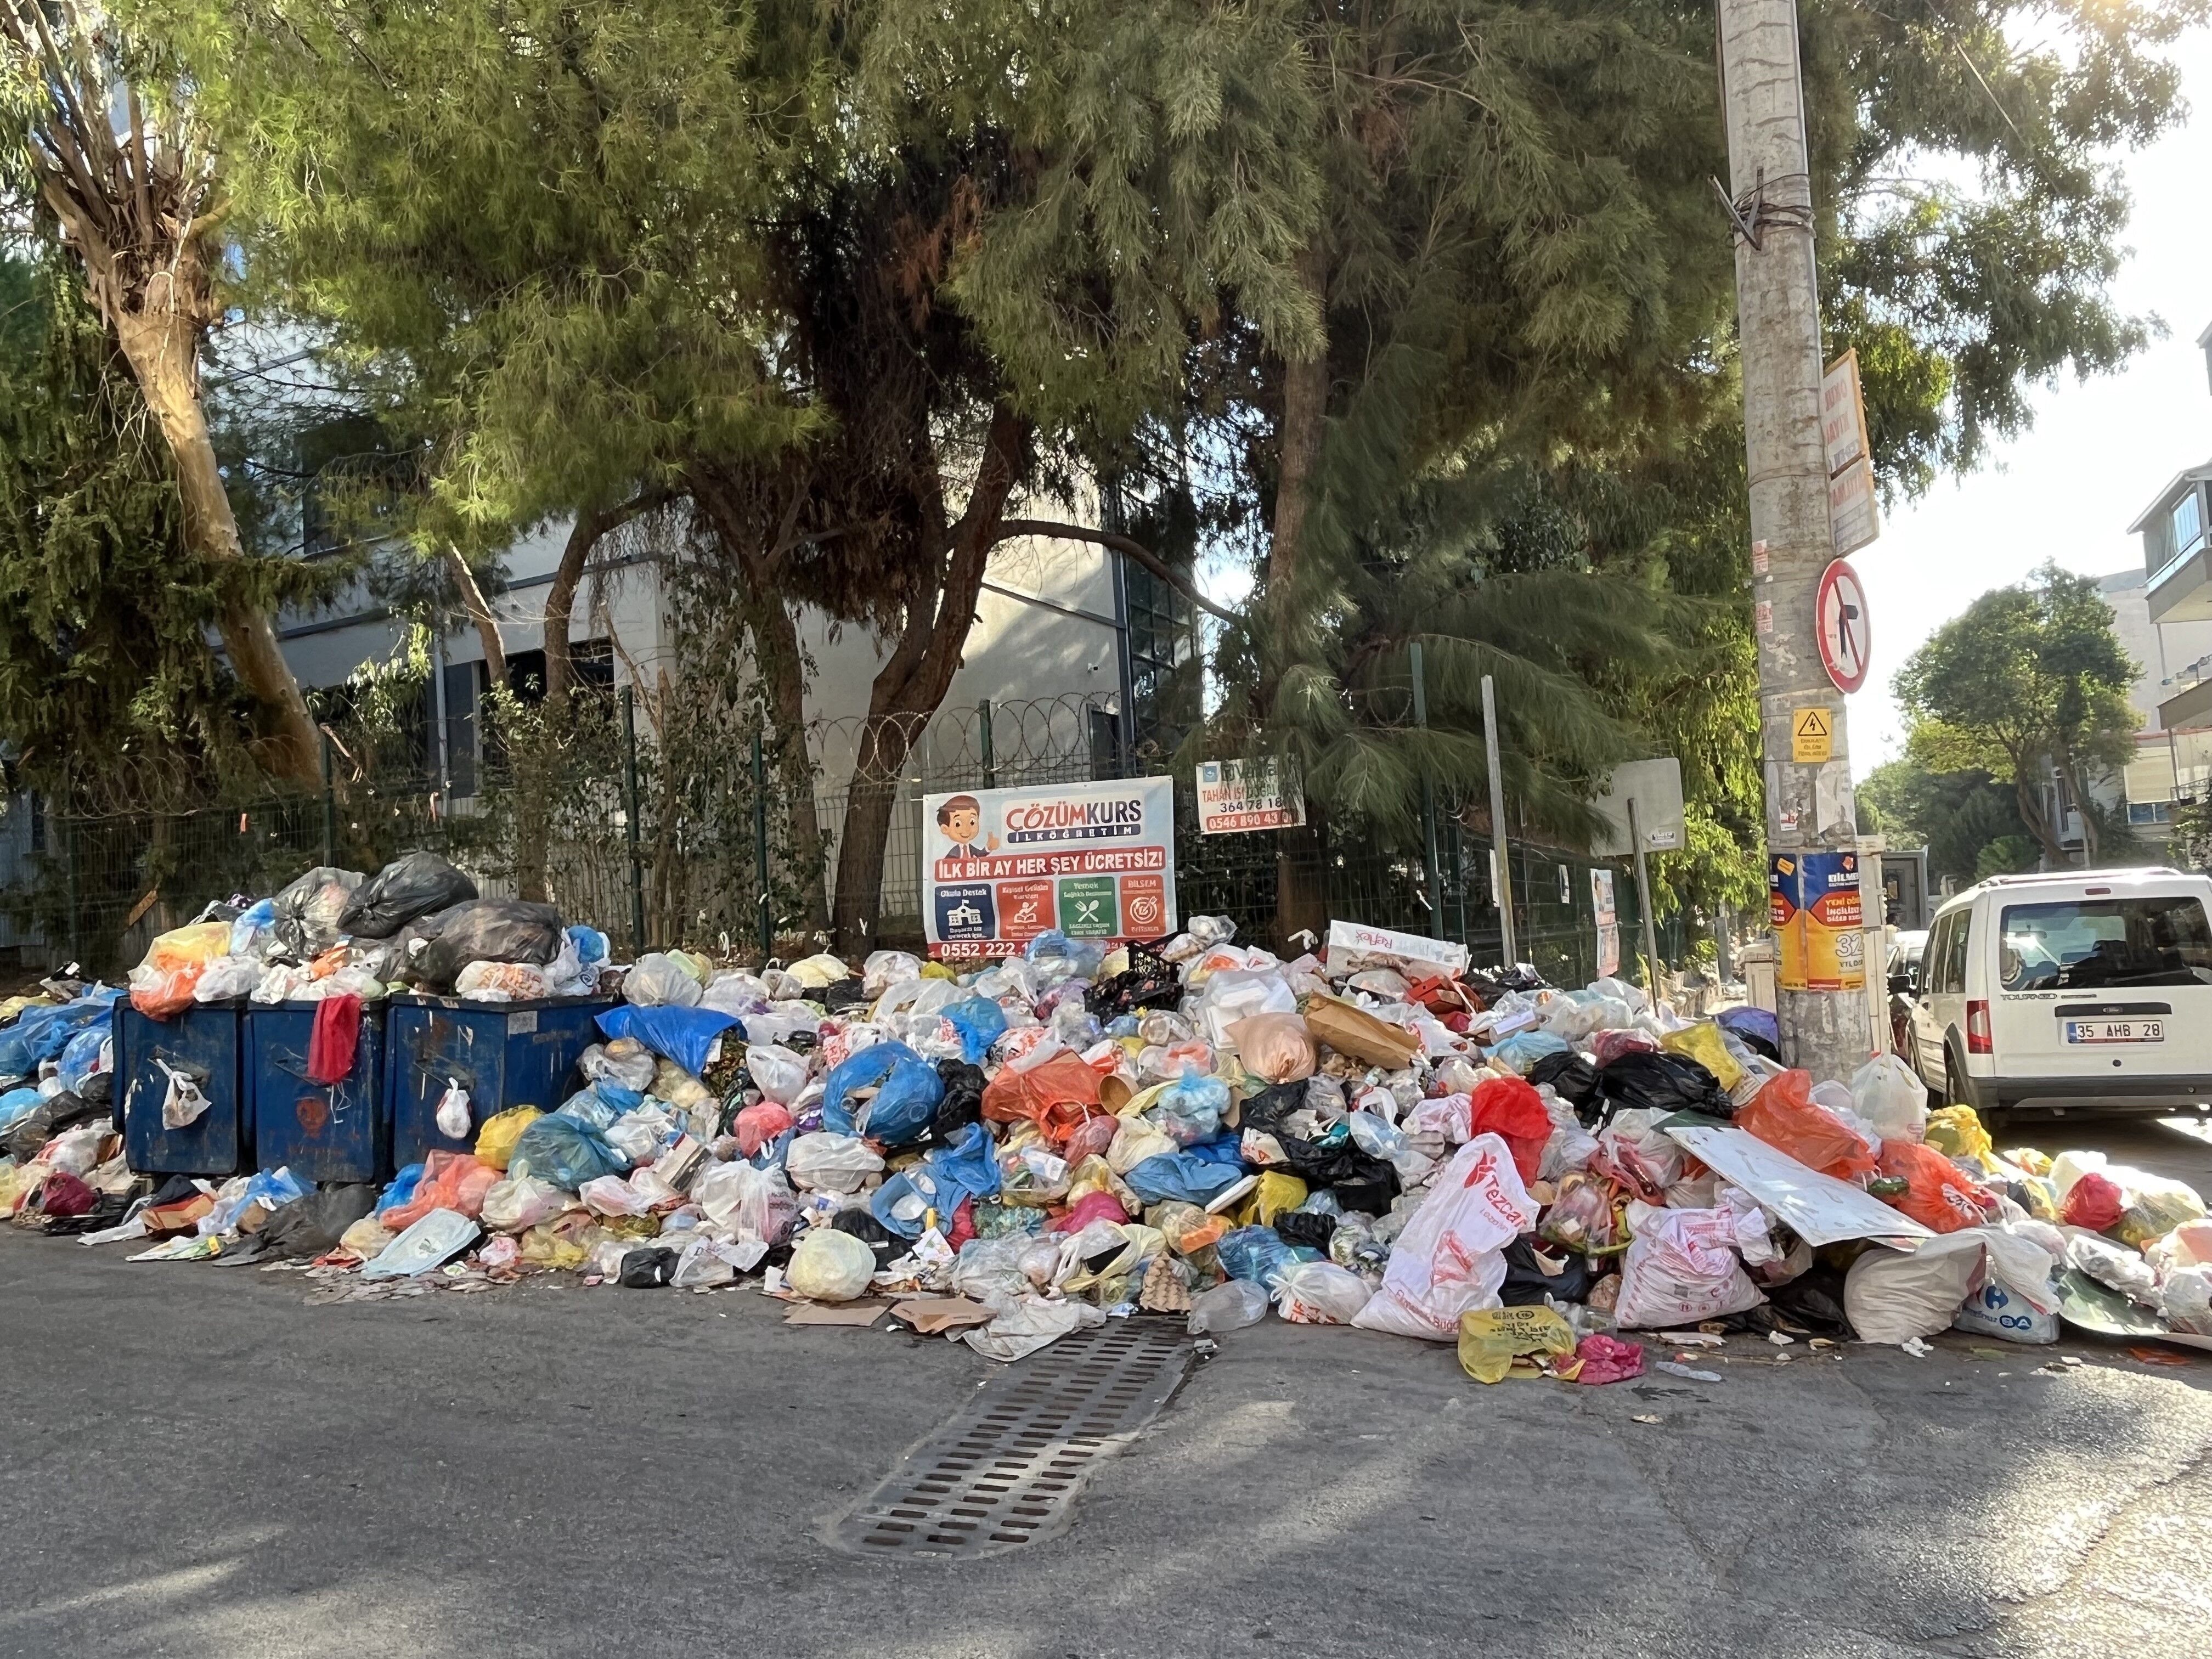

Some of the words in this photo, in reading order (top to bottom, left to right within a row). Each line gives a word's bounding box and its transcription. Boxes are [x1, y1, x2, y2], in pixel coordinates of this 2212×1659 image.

[1220, 802, 1243, 812] 364
[1247, 799, 1262, 810] 78
[1268, 797, 1282, 808] 18
[1209, 817, 1237, 830] 0546
[1240, 815, 1260, 826] 890
[1264, 812, 1278, 824] 43
[939, 860, 962, 878] İLK
[966, 858, 990, 877] BİR
[994, 860, 1012, 876] AY
[1017, 858, 1047, 874] HER
[1051, 856, 1080, 874] ŞEY
[1085, 848, 1163, 870] ÜCRETSİZ!
[1356, 930, 1392, 949] Reflex
[941, 943, 980, 956] 0552
[985, 943, 1015, 956] 222
[2078, 1025, 2094, 1038] 35
[2107, 1024, 2131, 1037] AHB
[2143, 1024, 2160, 1036] 28
